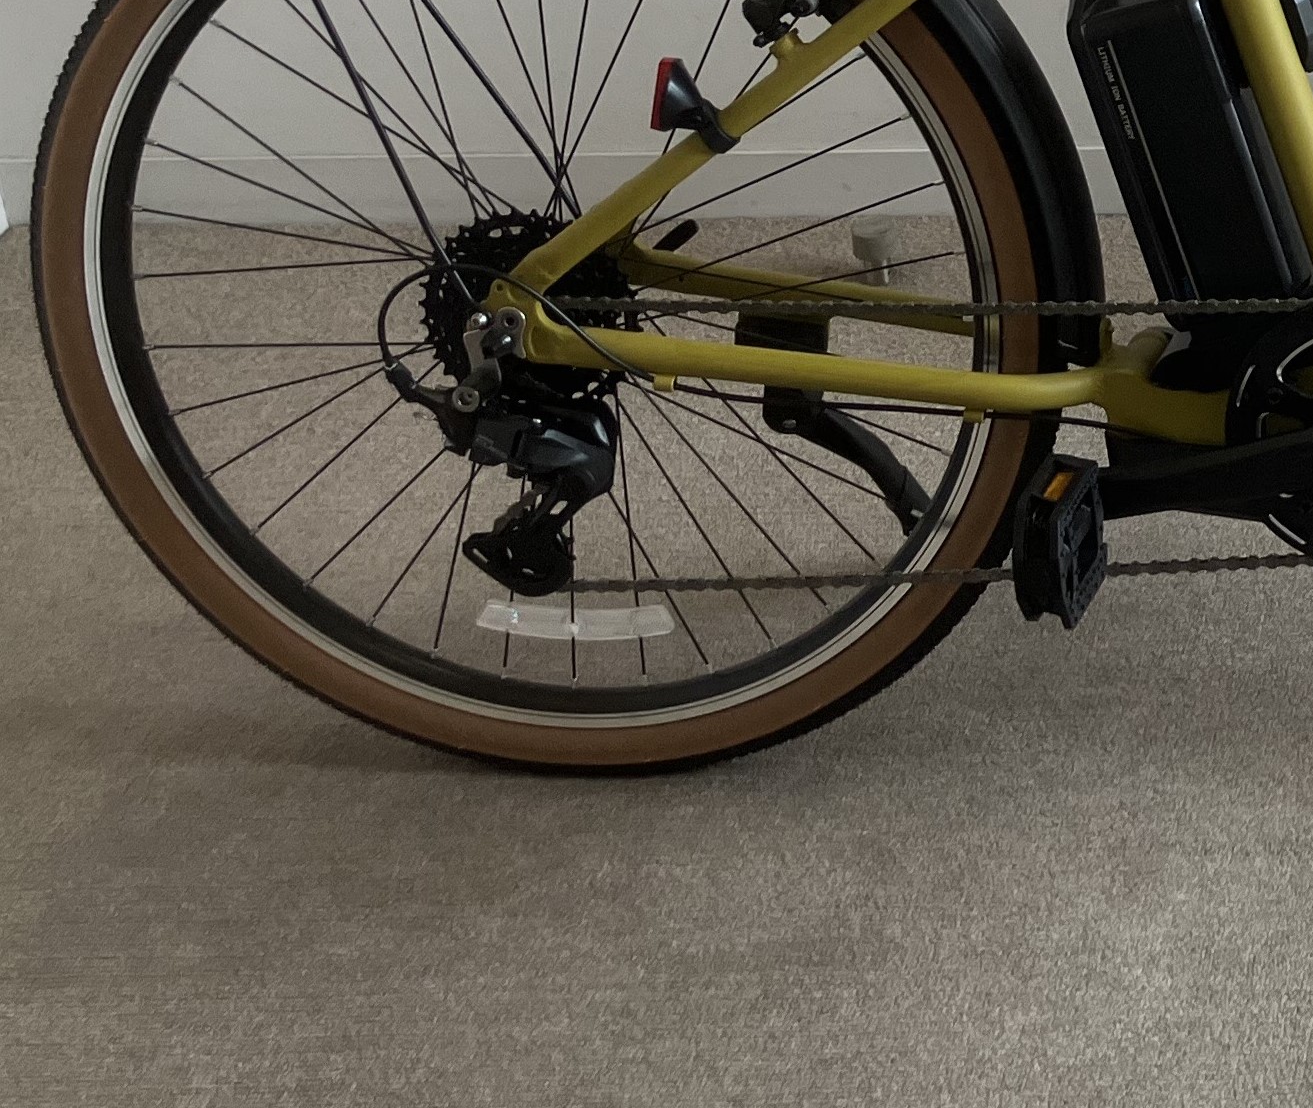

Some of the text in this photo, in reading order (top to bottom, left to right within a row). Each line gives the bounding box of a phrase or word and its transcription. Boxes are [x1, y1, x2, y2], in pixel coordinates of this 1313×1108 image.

[1096, 45, 1136, 141] LITHIUM ION BATTERY
